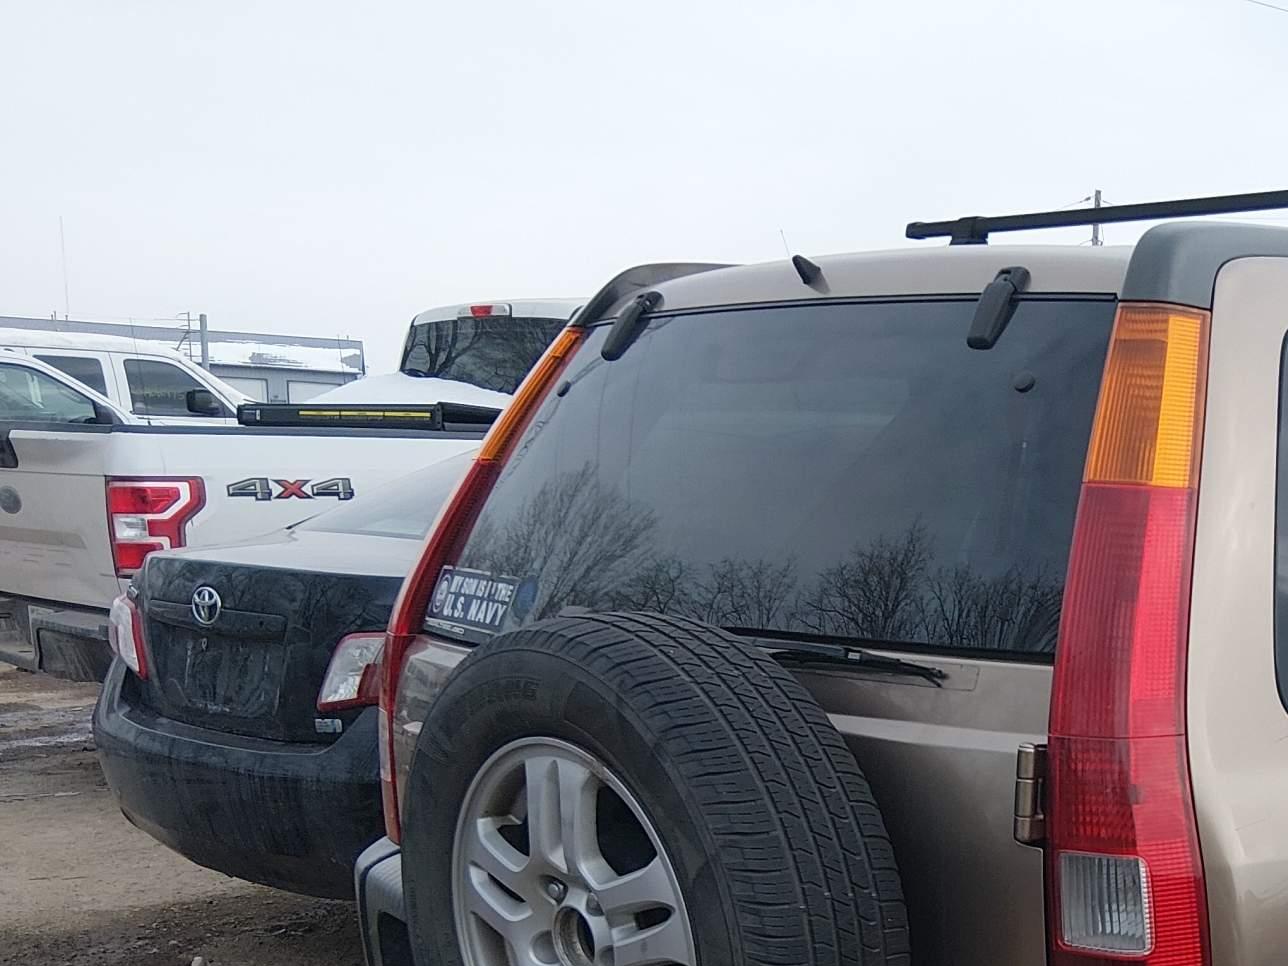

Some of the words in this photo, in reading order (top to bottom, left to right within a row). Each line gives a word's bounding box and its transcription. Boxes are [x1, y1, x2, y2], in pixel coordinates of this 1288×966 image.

[494, 582, 514, 602] THE
[443, 594, 465, 618] U.S.
[467, 599, 507, 626] NAVY
